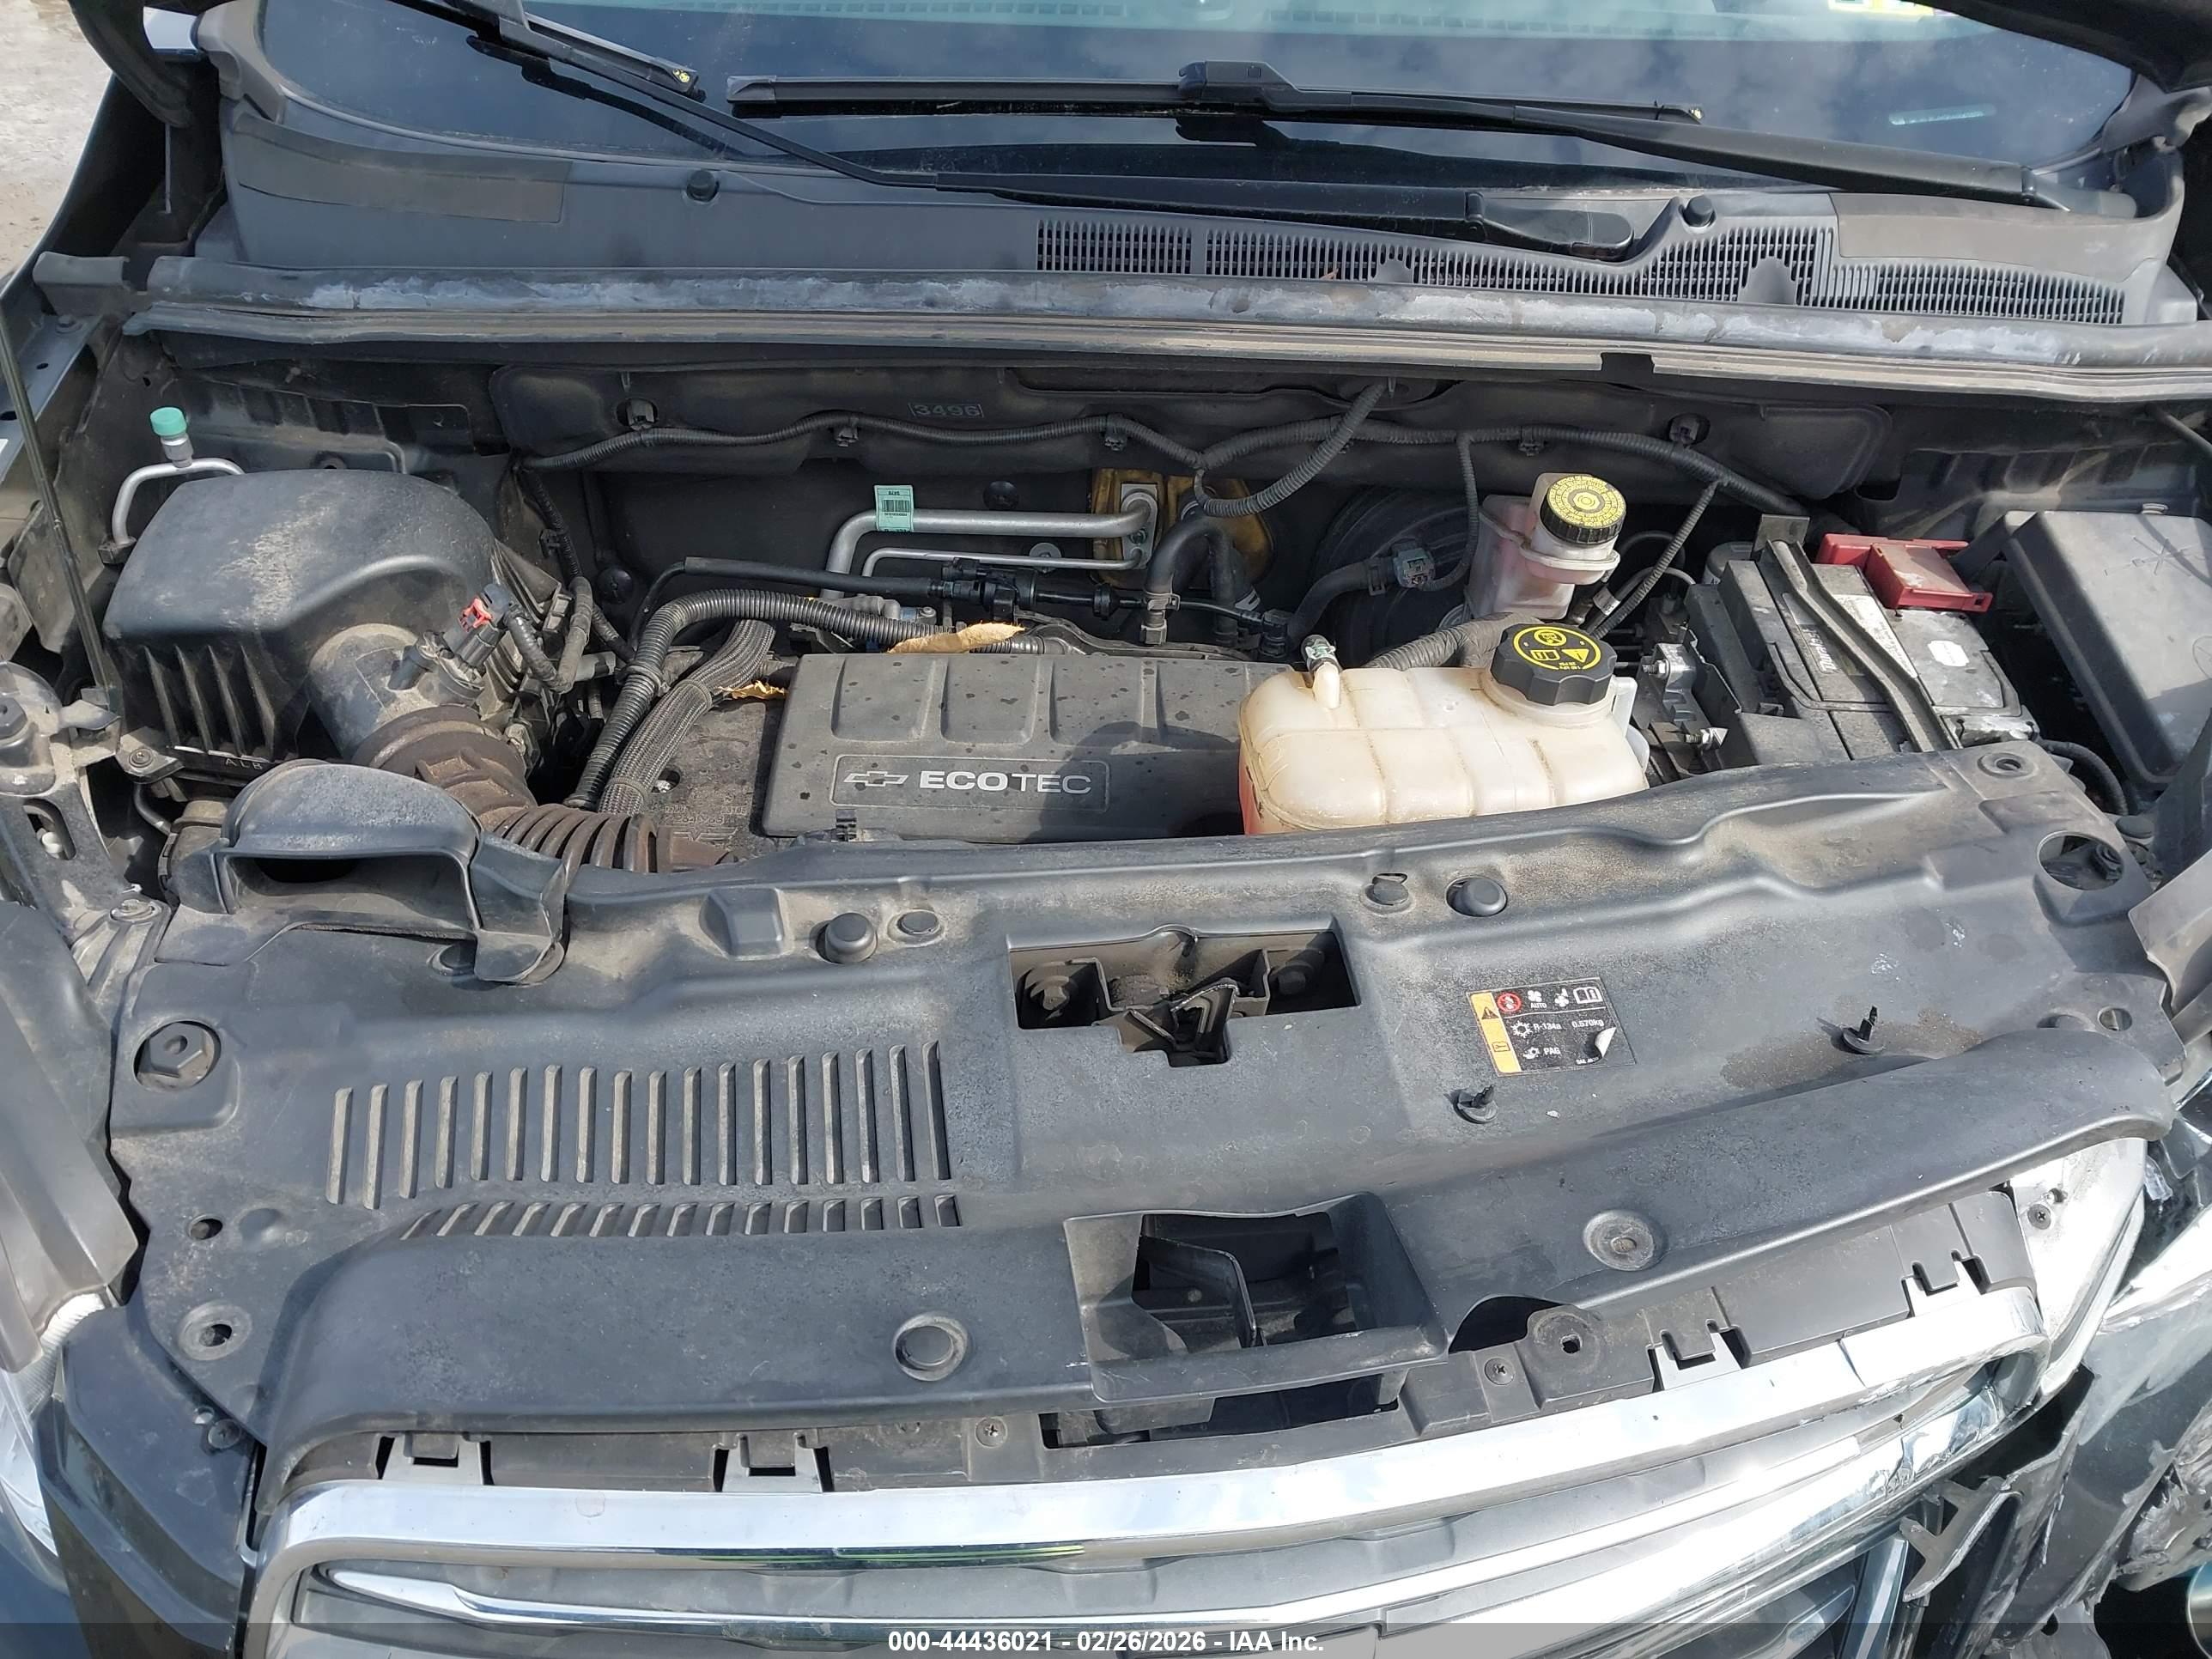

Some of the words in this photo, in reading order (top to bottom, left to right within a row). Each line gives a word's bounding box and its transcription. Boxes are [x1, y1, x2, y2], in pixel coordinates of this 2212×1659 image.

[914, 404, 981, 416] 3496
[919, 770, 1092, 794] ECOTEC
[1571, 1019, 1605, 1028] 0.570kg
[1543, 1047, 1562, 1055] PAG
